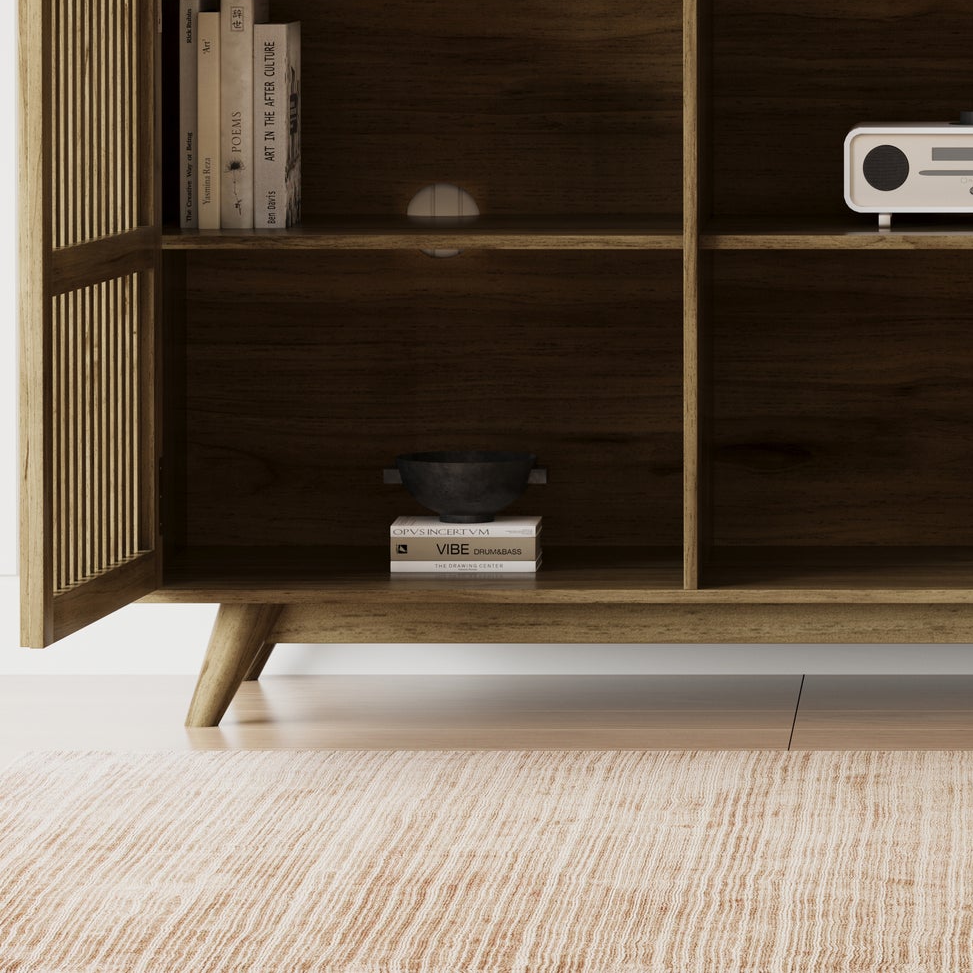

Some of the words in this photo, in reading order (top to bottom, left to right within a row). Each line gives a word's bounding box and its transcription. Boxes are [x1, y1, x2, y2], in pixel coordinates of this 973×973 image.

[264, 42, 275, 77] CULTURE
[264, 82, 275, 107] AFTER
[264, 112, 275, 126] THE
[231, 111, 242, 153] POEMS
[264, 131, 275, 140] IN
[264, 147, 275, 161] ART
[203, 157, 211, 174] Reza
[202, 175, 211, 204] Yasmina
[266, 191, 276, 209] Davis
[267, 212, 276, 224] Ben
[436, 543, 469, 555] VIBE
